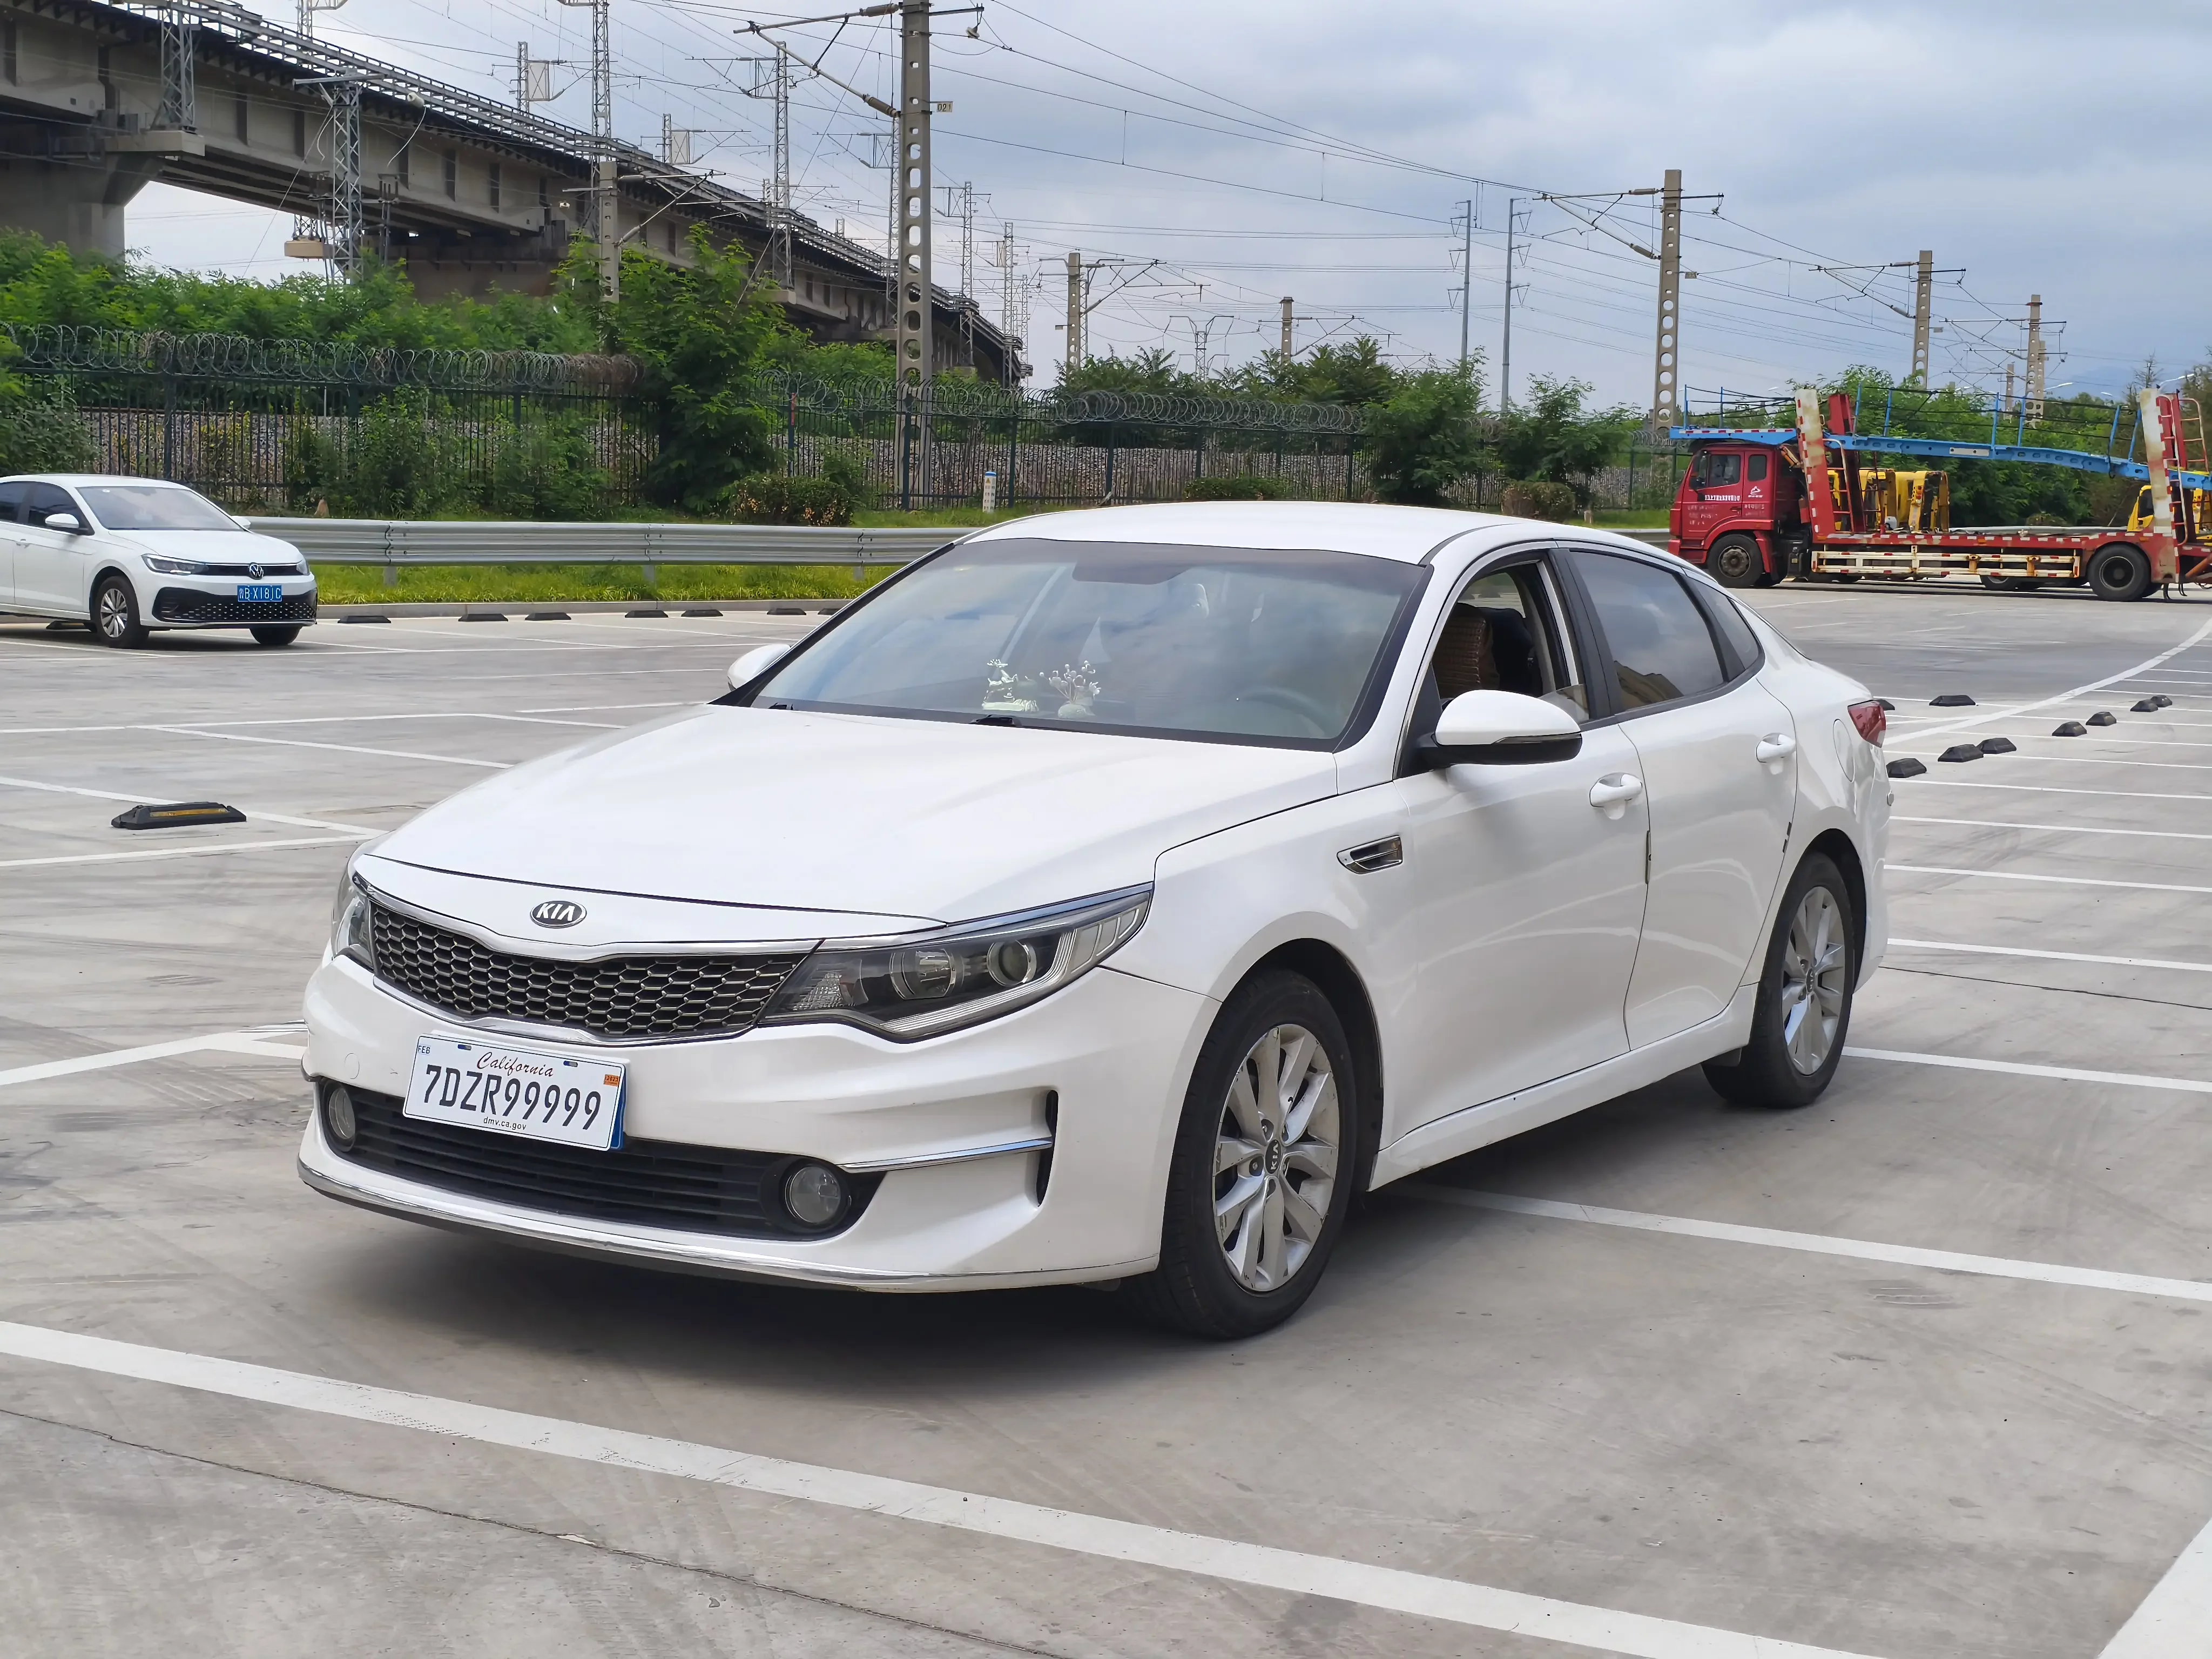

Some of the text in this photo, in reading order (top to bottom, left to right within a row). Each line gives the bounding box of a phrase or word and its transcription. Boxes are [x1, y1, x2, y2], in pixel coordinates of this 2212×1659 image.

[536, 903, 575, 921] KIA
[477, 1051, 554, 1077] California
[424, 1064, 602, 1130] 7DZR99999
[483, 1116, 527, 1131] dmv.ca.gov
[1270, 1142, 1278, 1170] KIA
